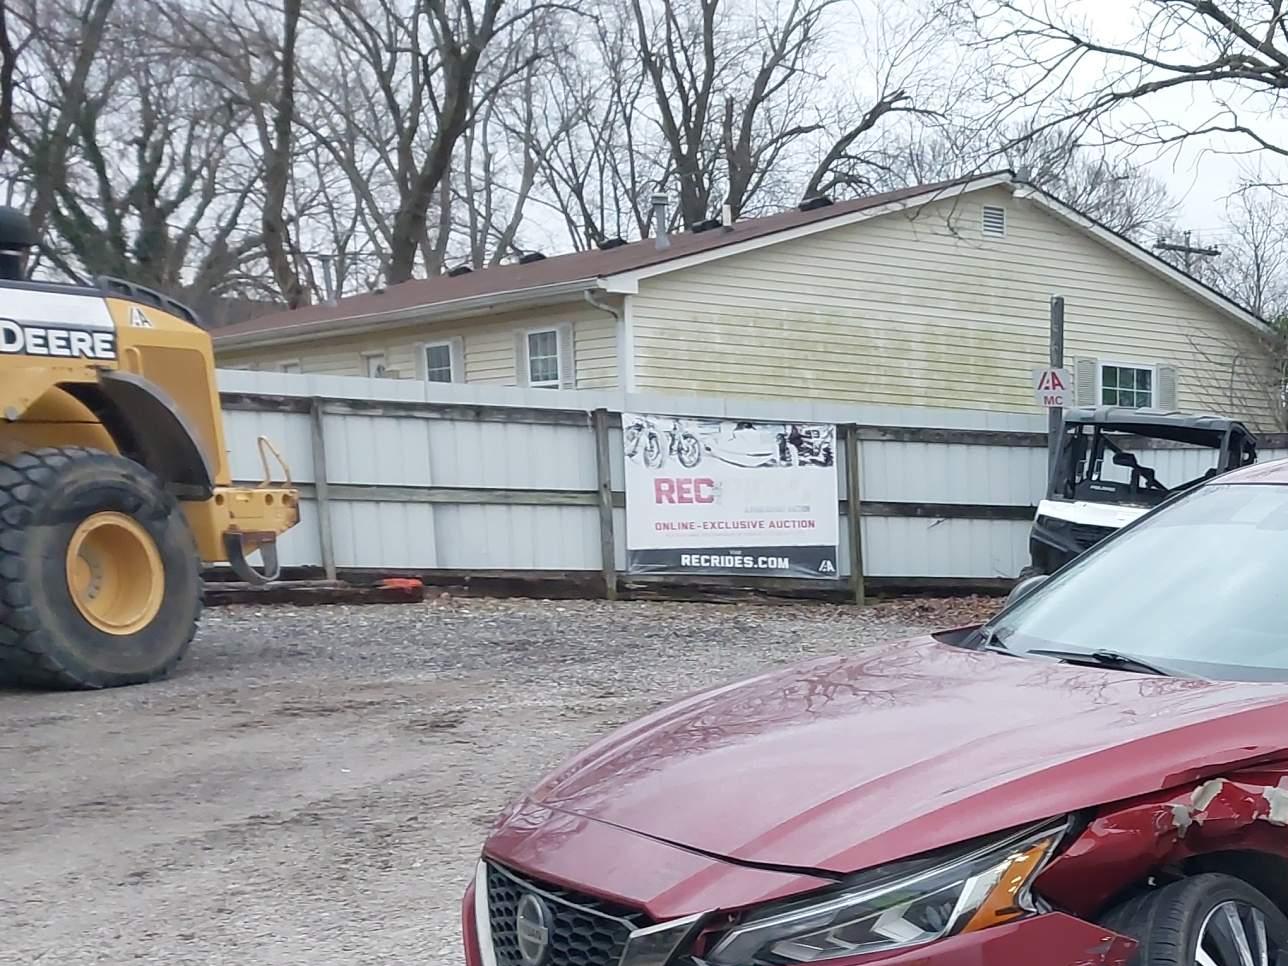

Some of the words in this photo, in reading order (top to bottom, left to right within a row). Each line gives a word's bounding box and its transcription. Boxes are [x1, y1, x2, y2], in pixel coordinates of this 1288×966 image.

[0, 320, 116, 359] DEERE
[1043, 396, 1063, 405] MC
[655, 520, 764, 531] ONLINE-EXCLUSIVE
[768, 519, 815, 529] AUCTION
[681, 554, 789, 569] RECRIDES.COM
